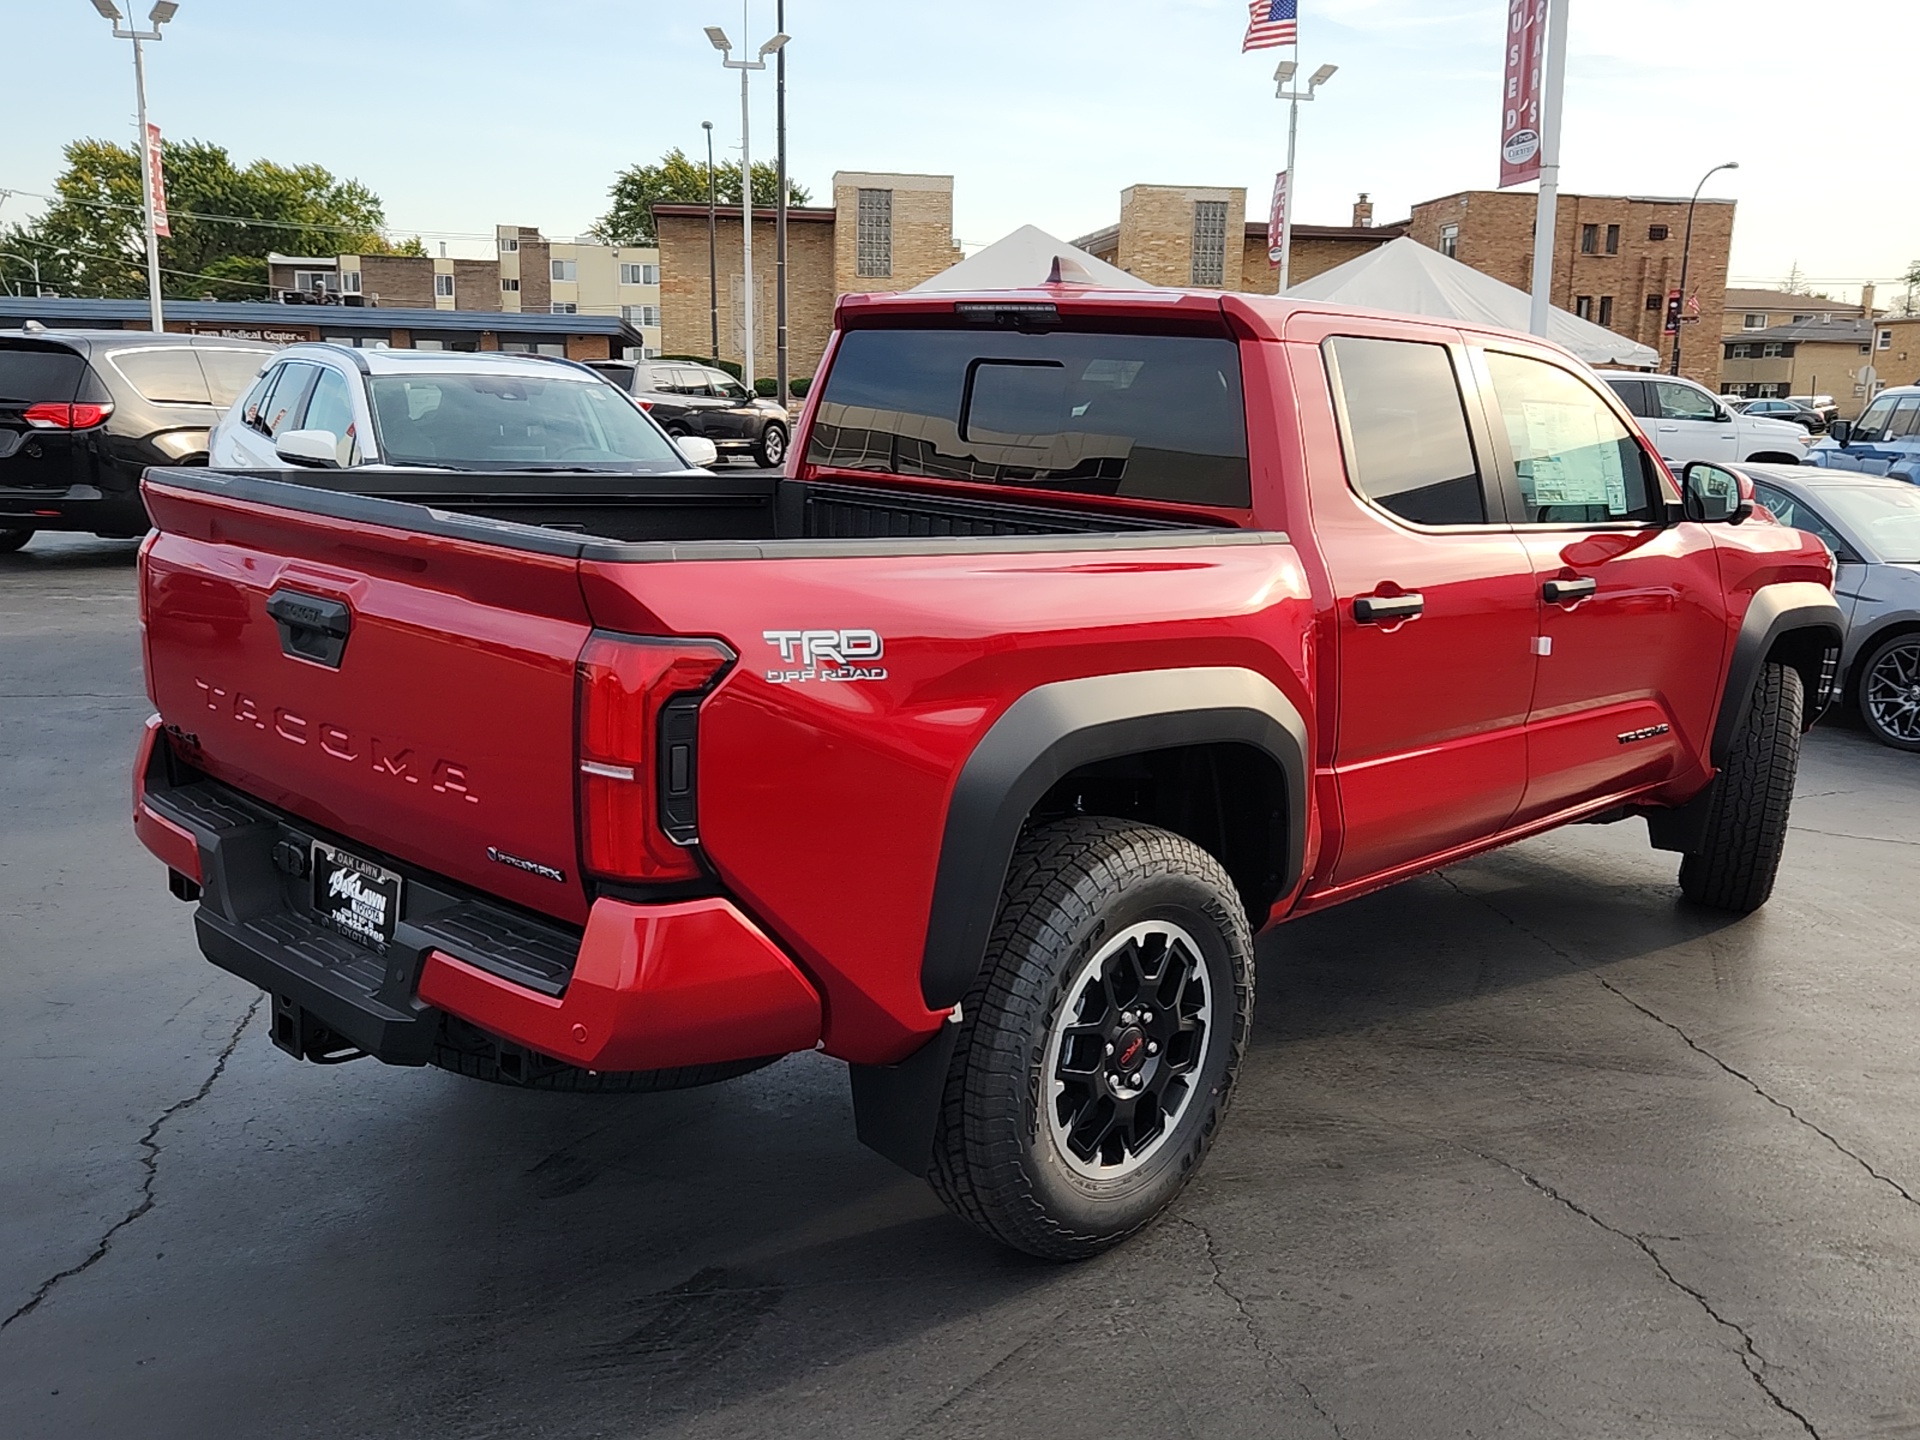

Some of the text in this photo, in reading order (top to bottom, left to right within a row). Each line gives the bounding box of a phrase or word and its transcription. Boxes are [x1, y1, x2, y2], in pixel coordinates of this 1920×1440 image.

[1507, 11, 1523, 131] USED
[1529, 0, 1545, 123] CARS
[221, 329, 262, 340] Medical
[263, 330, 297, 342] Center
[762, 629, 884, 670] TRD
[765, 665, 889, 684] OFF ROAD
[195, 677, 479, 804] TACOMA
[1617, 722, 1669, 744] TACOMA
[337, 853, 379, 878] OAK LAWN
[353, 901, 381, 921] TOYOTA
[336, 922, 369, 946] TOYOTA
